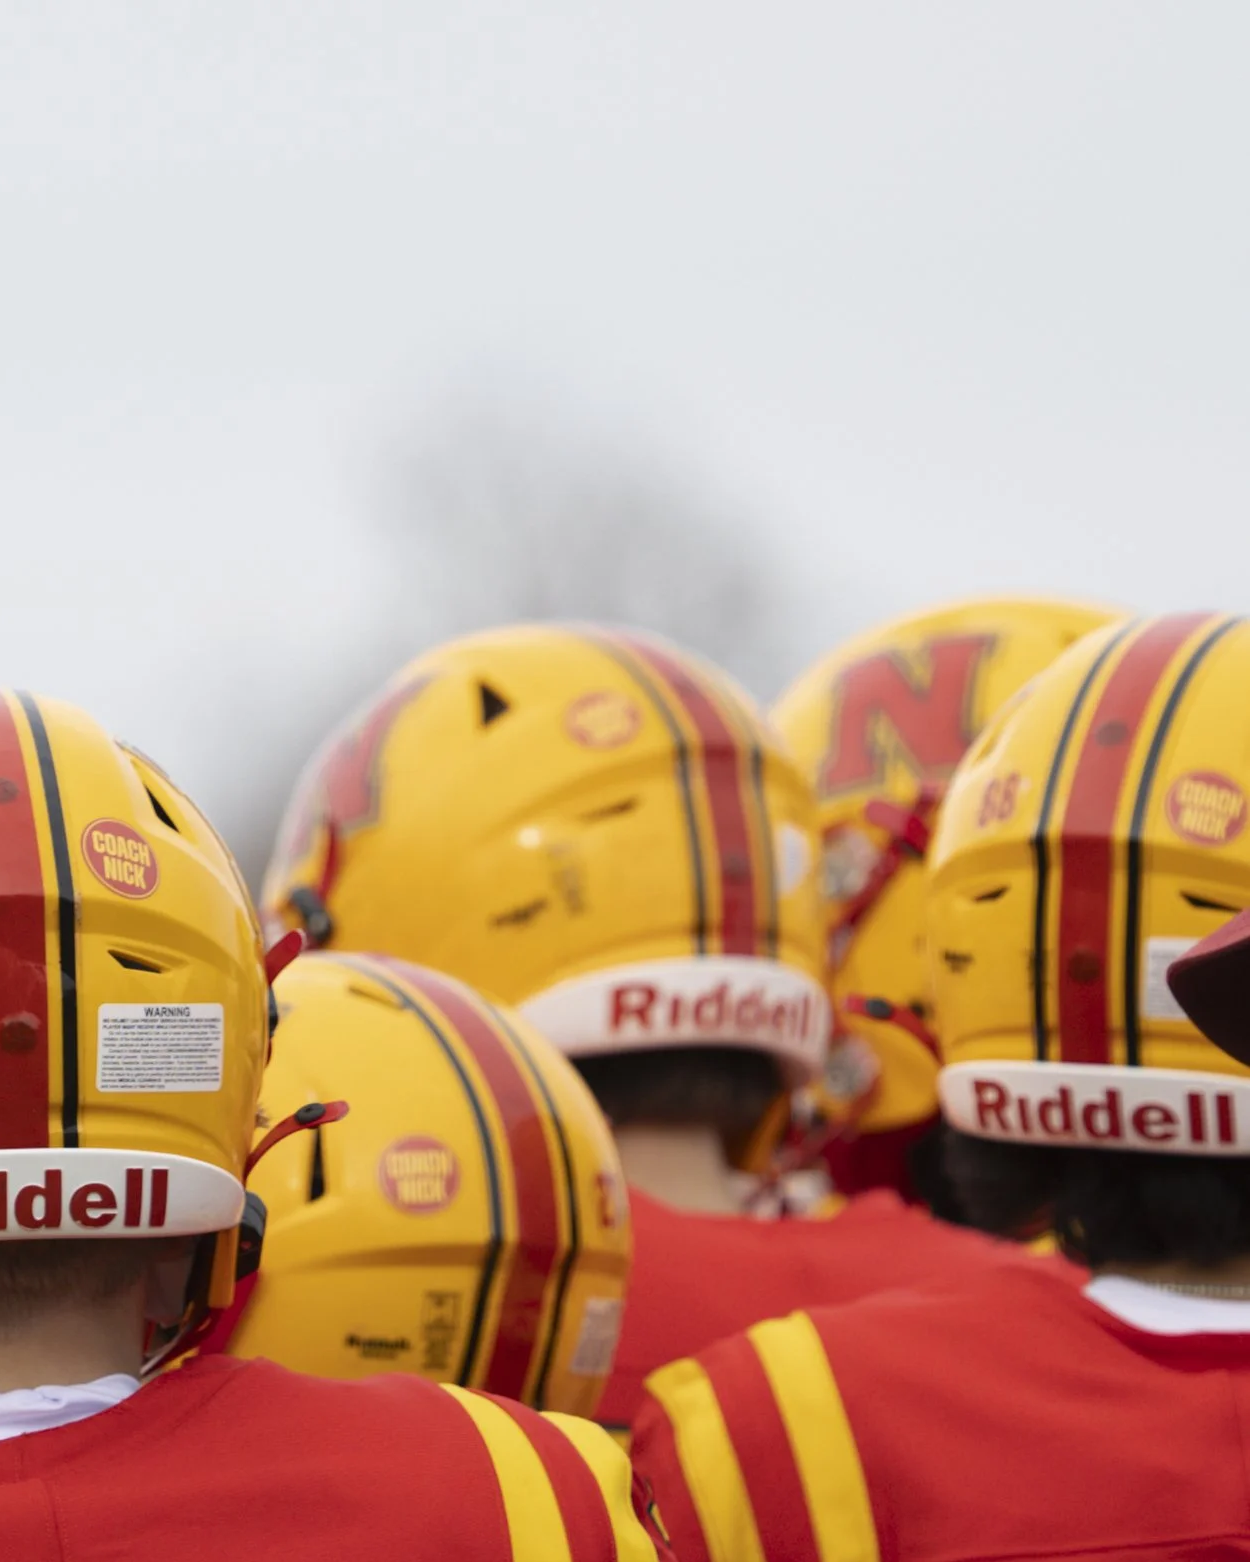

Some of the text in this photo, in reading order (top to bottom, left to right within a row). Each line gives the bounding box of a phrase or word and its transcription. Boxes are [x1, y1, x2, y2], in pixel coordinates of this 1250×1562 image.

[816, 632, 998, 798] N
[91, 829, 151, 867] COACH
[103, 855, 147, 889] NICK
[144, 1006, 191, 1017] WARNING
[610, 981, 810, 1040] Riddell
[971, 1079, 1236, 1145] Riddell
